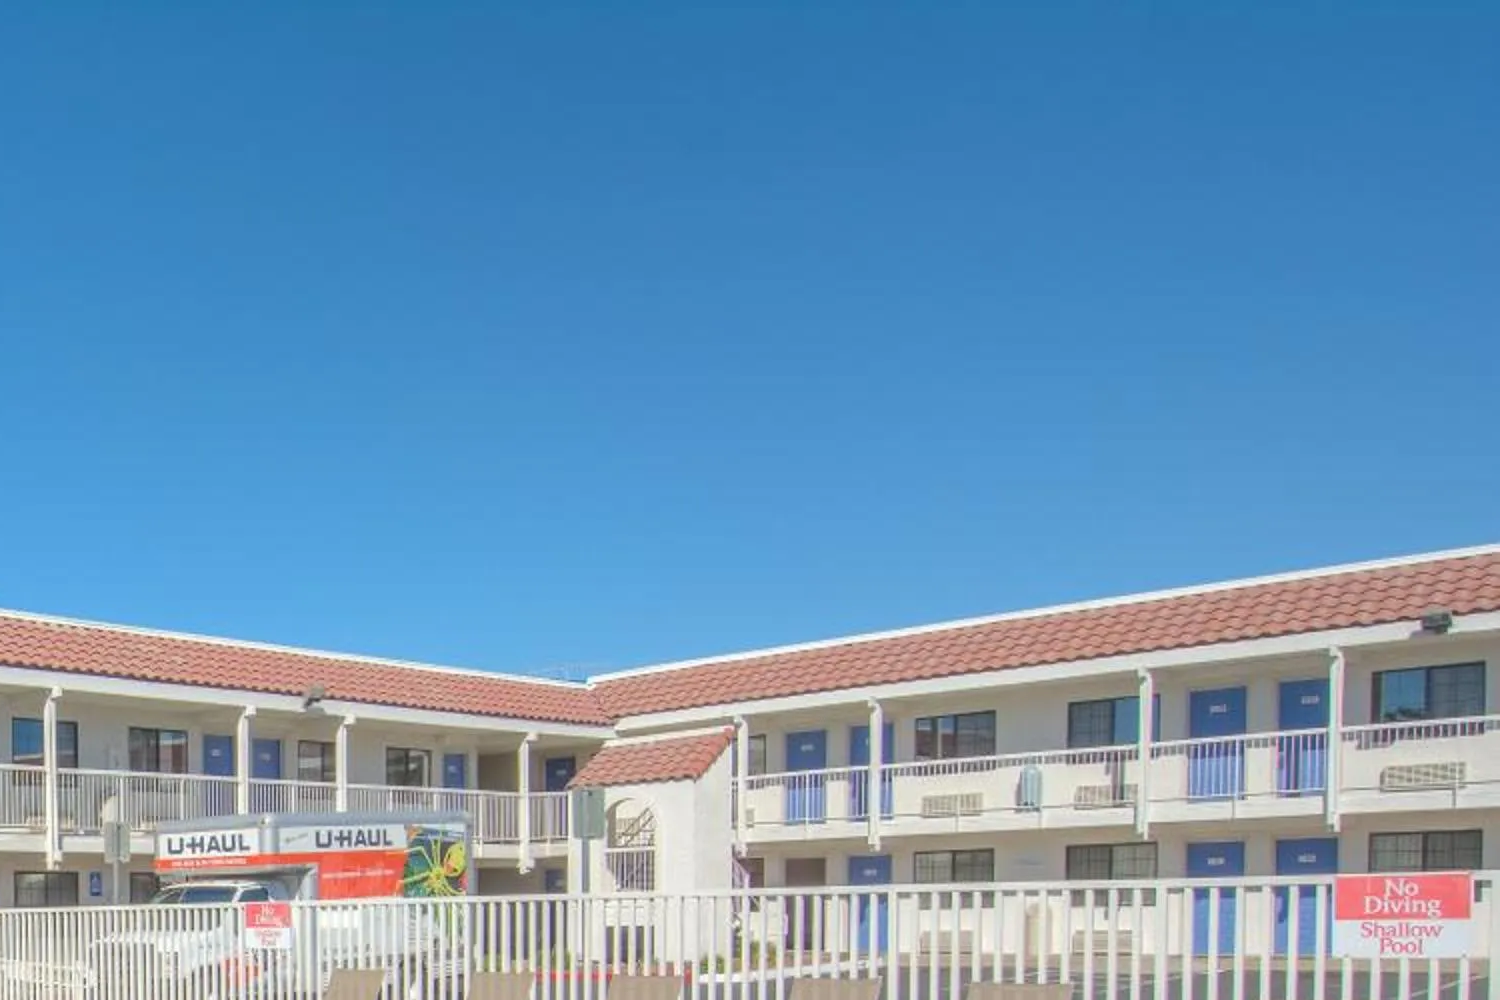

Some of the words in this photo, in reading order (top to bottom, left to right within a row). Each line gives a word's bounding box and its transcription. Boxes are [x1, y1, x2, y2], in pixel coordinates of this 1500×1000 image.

[1384, 879, 1419, 897] No
[1363, 896, 1443, 918] Diving
[1360, 922, 1445, 939] Shallow
[1379, 938, 1424, 955] Pool
